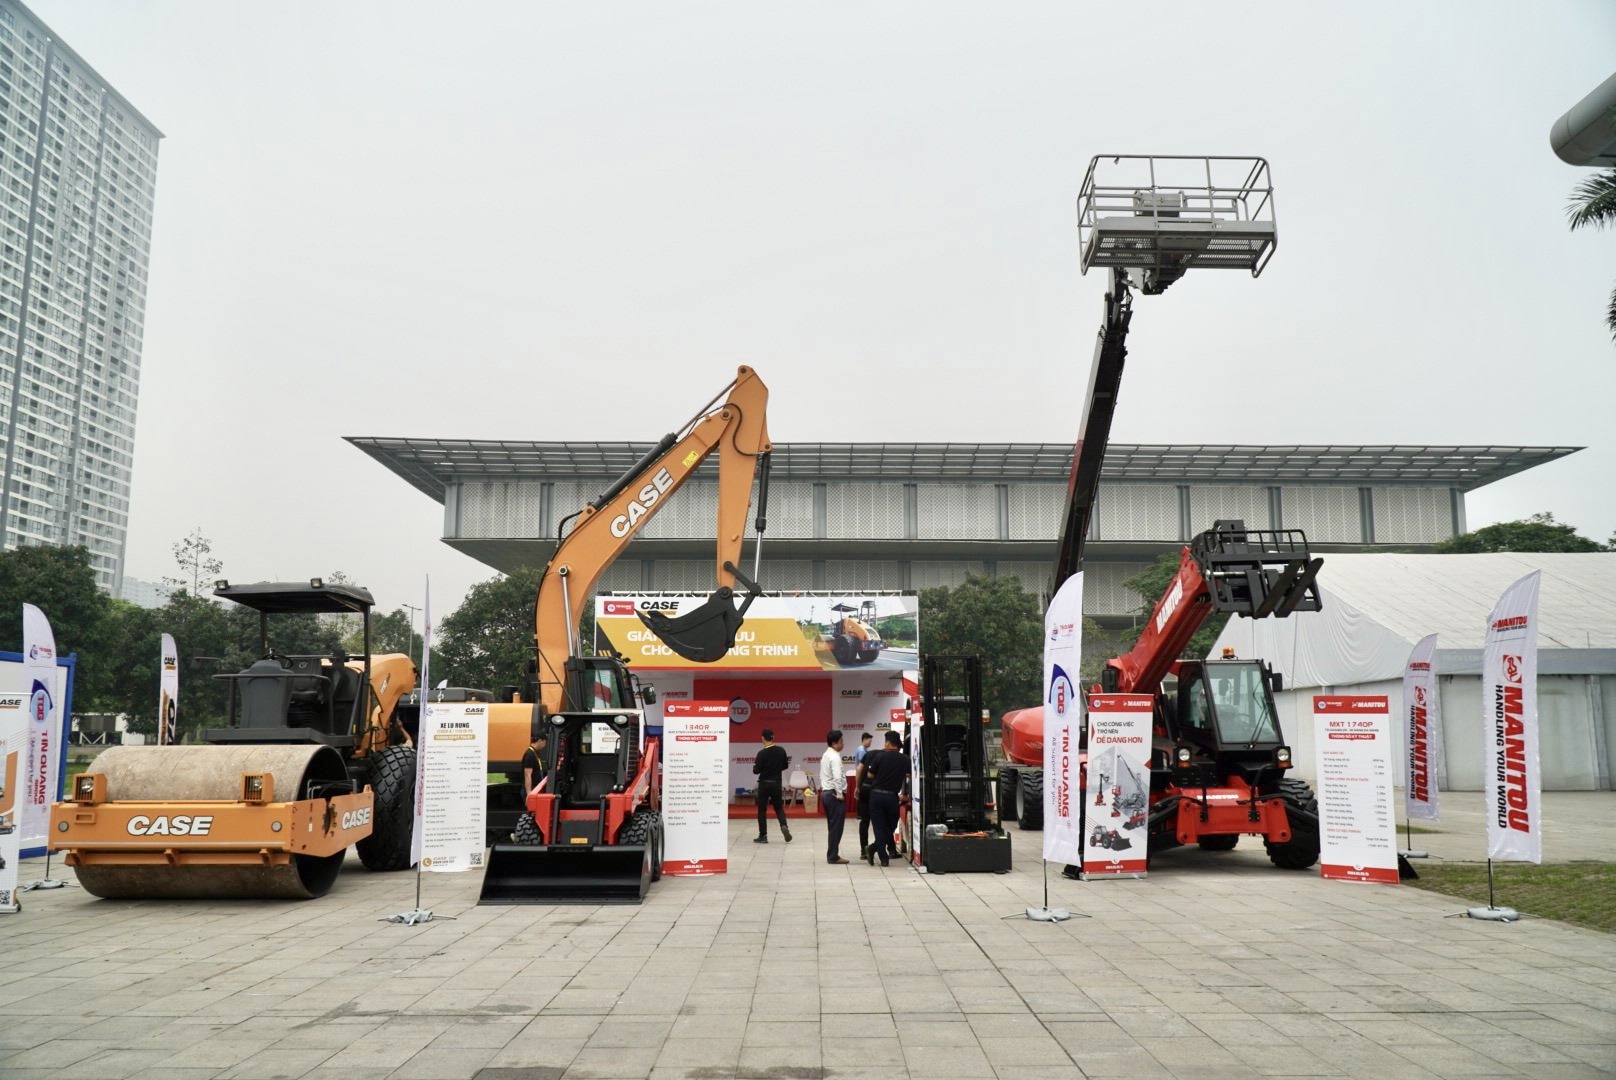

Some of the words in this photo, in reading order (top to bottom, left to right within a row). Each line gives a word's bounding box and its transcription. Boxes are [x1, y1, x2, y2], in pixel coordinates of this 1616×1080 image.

[610, 467, 674, 538] CASE
[641, 602, 679, 610] CASE
[1156, 577, 1183, 634] MANITOU
[1497, 616, 1527, 628] MANITOU
[641, 645, 673, 655] CHO
[752, 643, 798, 656] TRÌNH
[769, 701, 800, 709] QUANG
[1057, 682, 1065, 714] TQG
[1496, 685, 1504, 746] HANDLING
[1415, 706, 1429, 802] MANITOU
[1497, 750, 1505, 782] YOUR
[1504, 686, 1530, 833] MANITOU
[39, 754, 47, 805] QUANG
[1062, 756, 1070, 818] QUANG
[341, 808, 371, 830] CASE
[1497, 785, 1507, 828] WORLD
[127, 815, 213, 836] CASE
